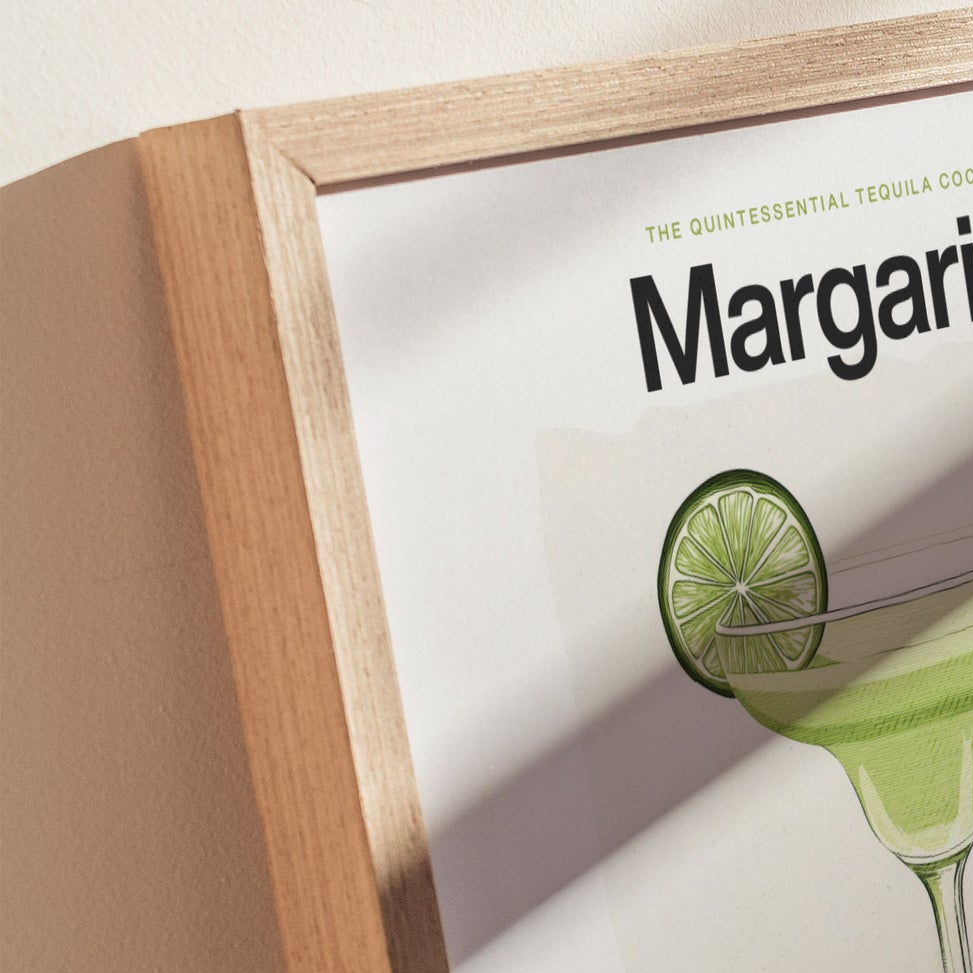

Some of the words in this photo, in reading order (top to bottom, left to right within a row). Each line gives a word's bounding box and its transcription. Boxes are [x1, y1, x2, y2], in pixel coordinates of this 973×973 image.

[644, 221, 684, 243] THE
[689, 191, 850, 236] QUINTESSENTIAL
[855, 175, 933, 206] TEQUILA
